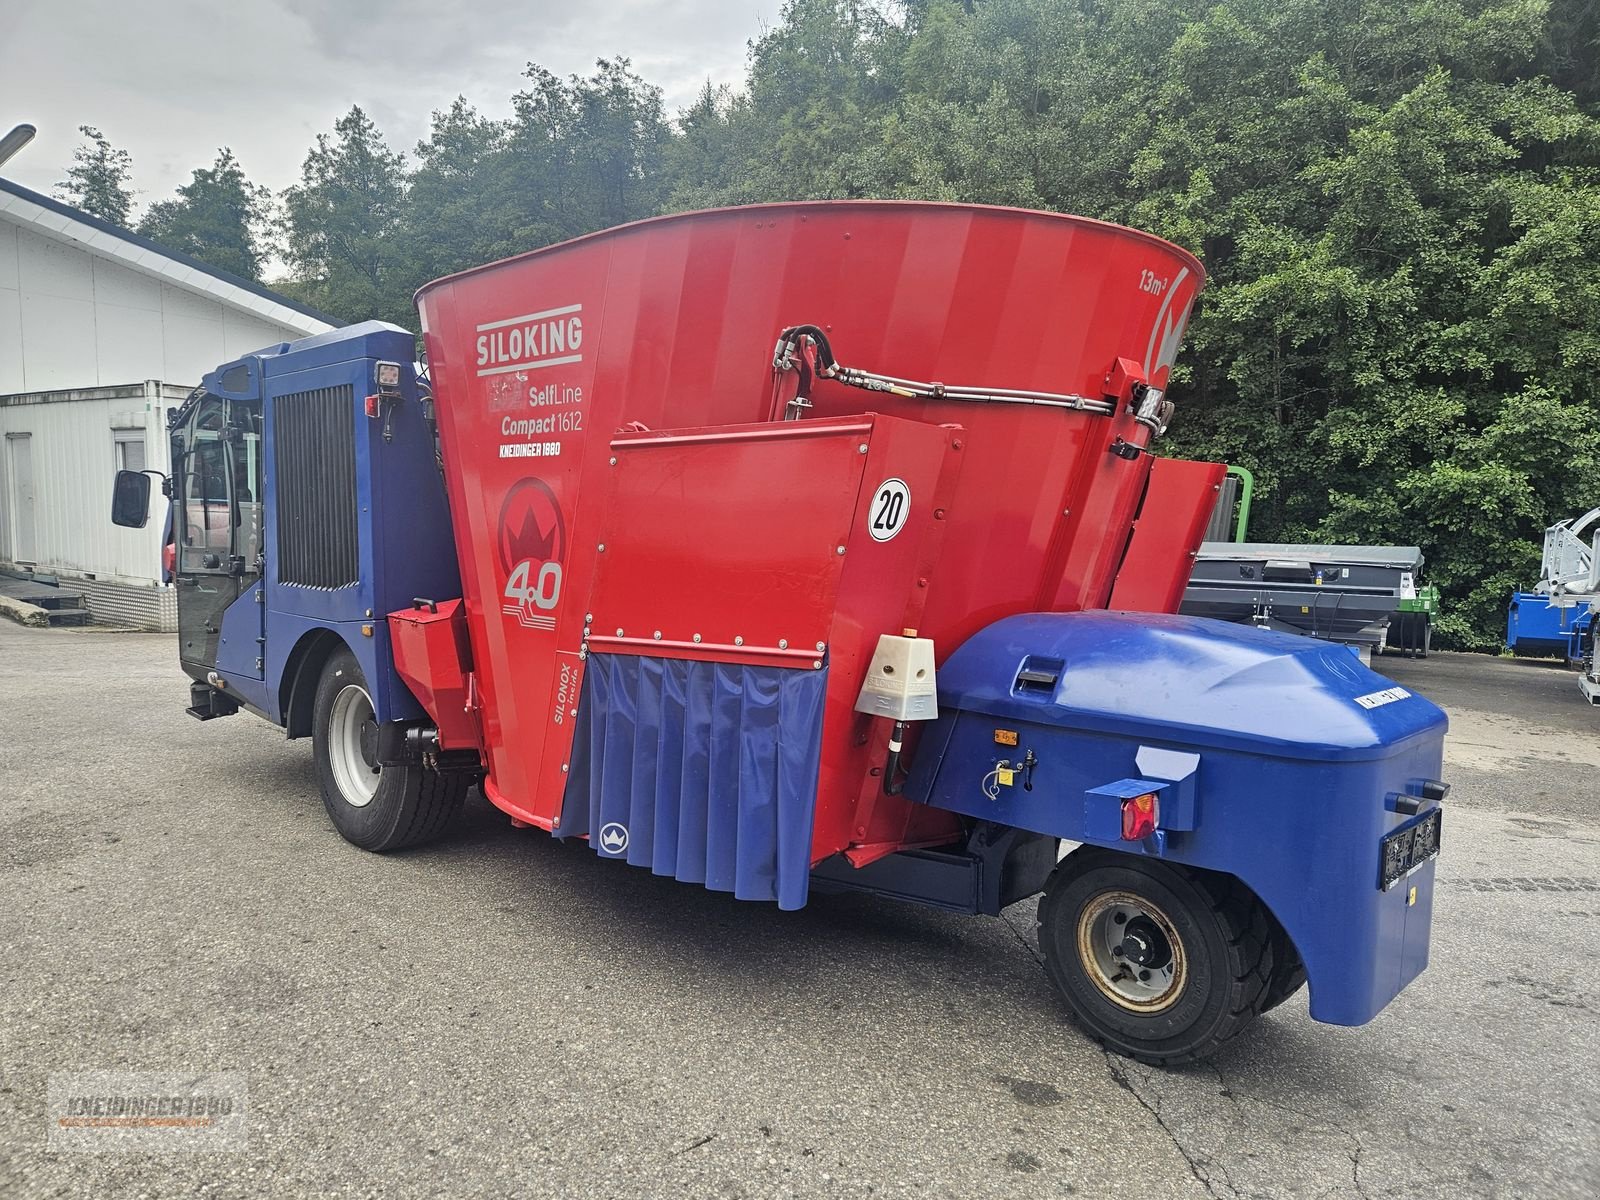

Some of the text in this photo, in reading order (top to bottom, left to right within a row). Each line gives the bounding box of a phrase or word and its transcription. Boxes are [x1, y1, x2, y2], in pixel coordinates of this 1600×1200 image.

[476, 317, 583, 366] SILOKING
[529, 383, 582, 407] SelfLine
[501, 411, 583, 440] Compact 1612
[499, 441, 561, 458] KNEIDINGER 1880
[873, 489, 904, 530] 20
[554, 662, 571, 725] SILONOX
